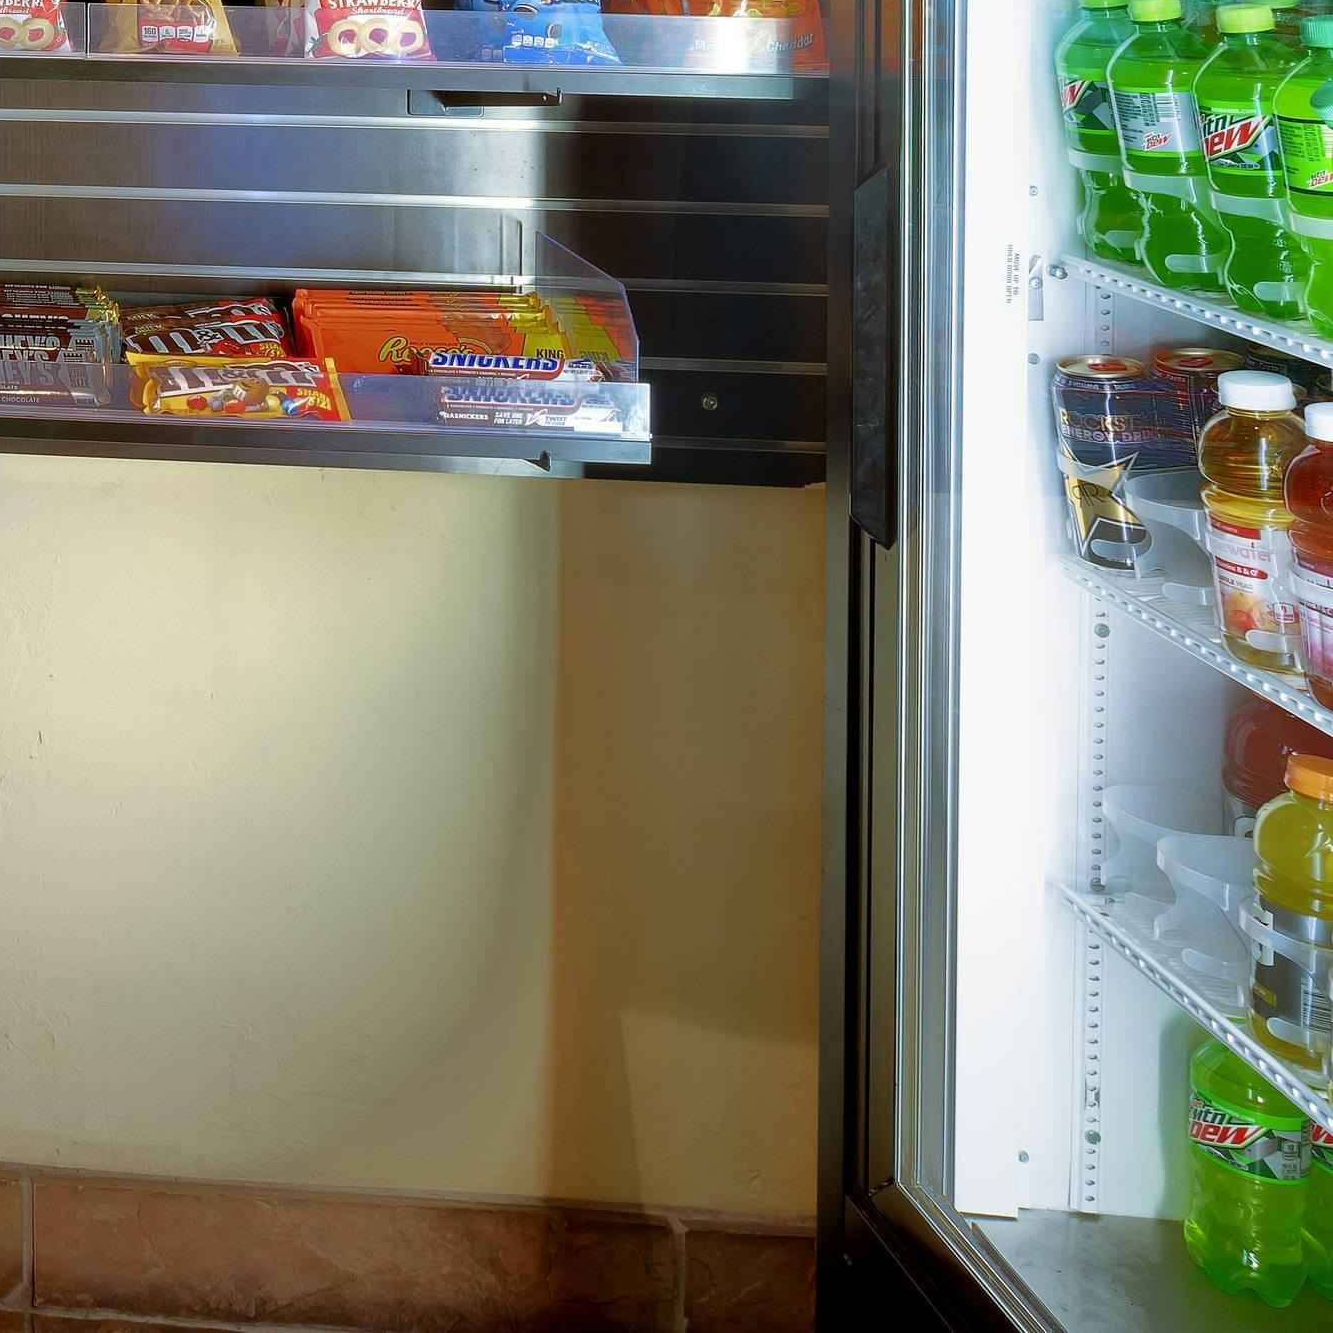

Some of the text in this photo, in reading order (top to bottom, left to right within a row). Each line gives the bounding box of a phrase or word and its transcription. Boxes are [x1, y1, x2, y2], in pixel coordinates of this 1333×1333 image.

[350, 6, 405, 17] Shortbread
[766, 32, 814, 52] Cheddar
[536, 348, 564, 359] KING
[1061, 426, 1114, 442] ENERGY
